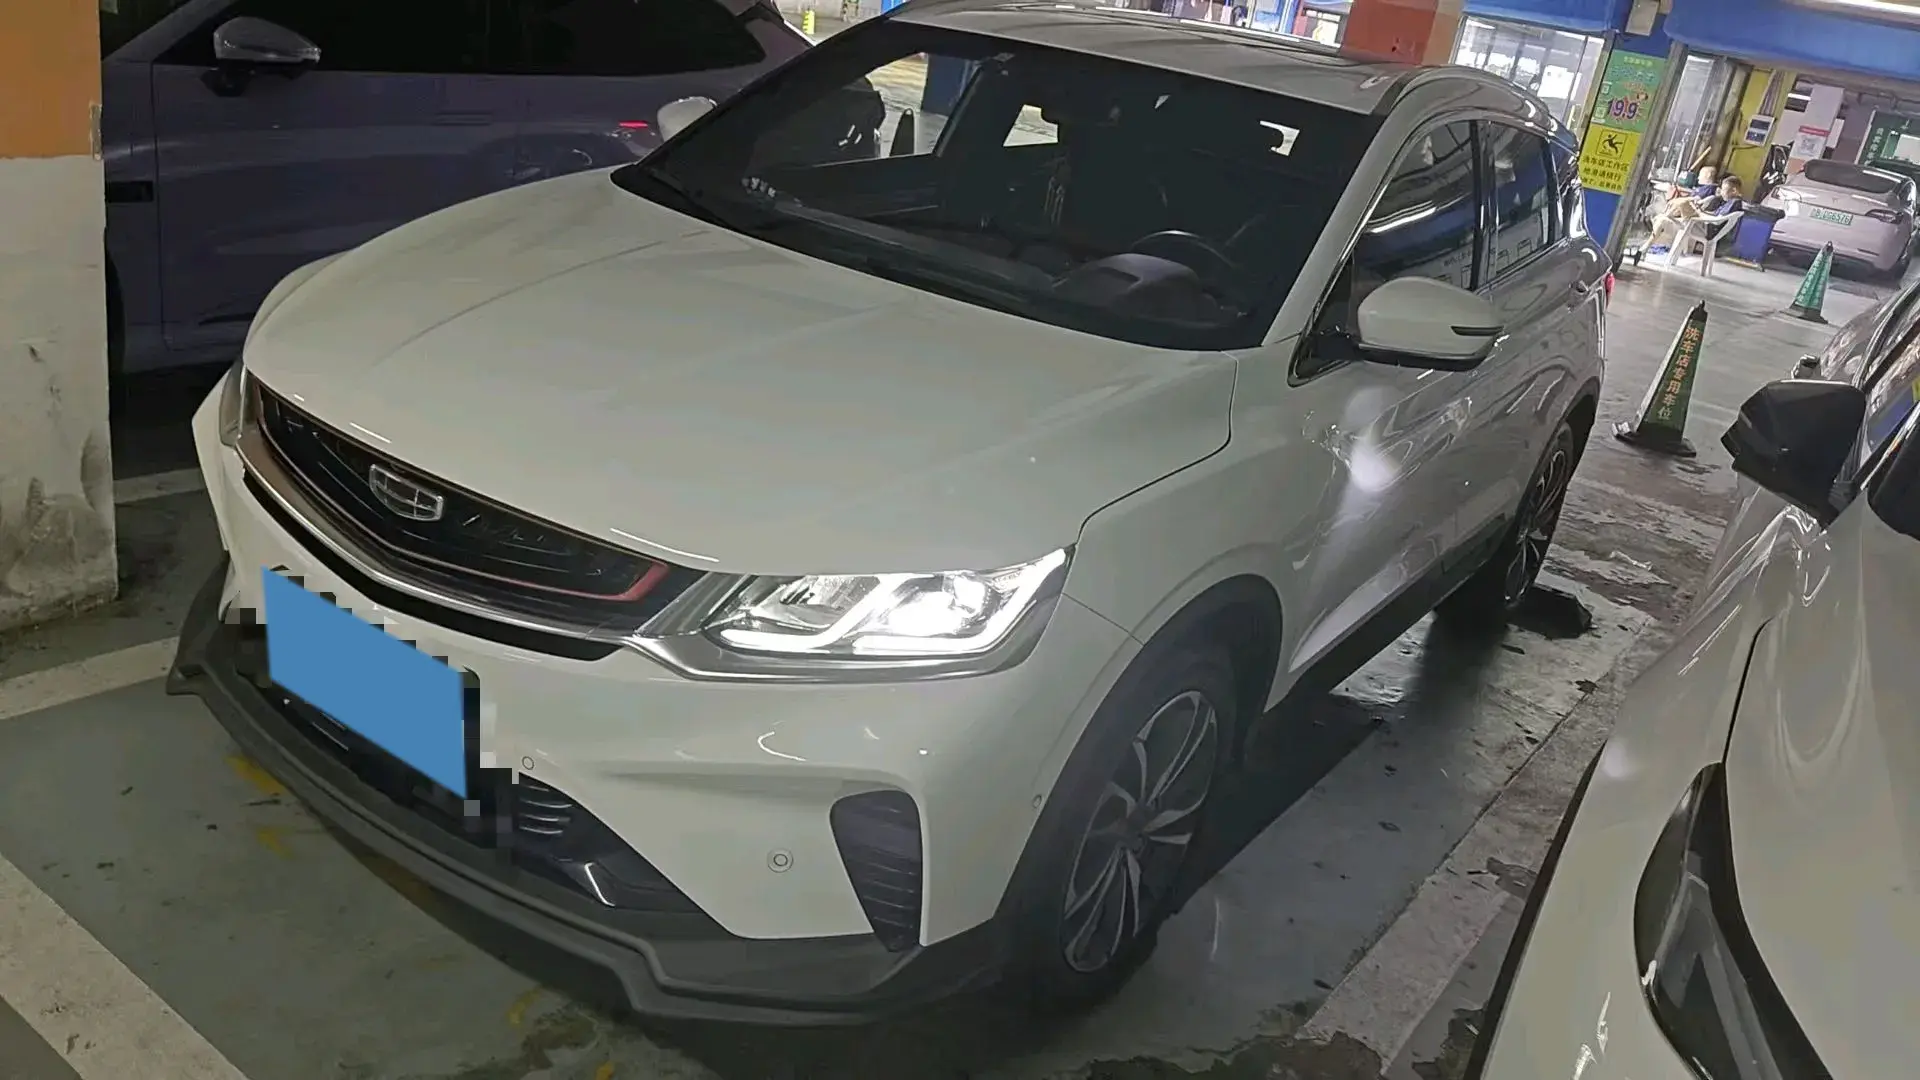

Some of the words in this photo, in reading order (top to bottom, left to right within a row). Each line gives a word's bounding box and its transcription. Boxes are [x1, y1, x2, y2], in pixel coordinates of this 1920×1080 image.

[1607, 97, 1638, 120] 19.9
[1657, 327, 1700, 420] 洗车店专用车位
